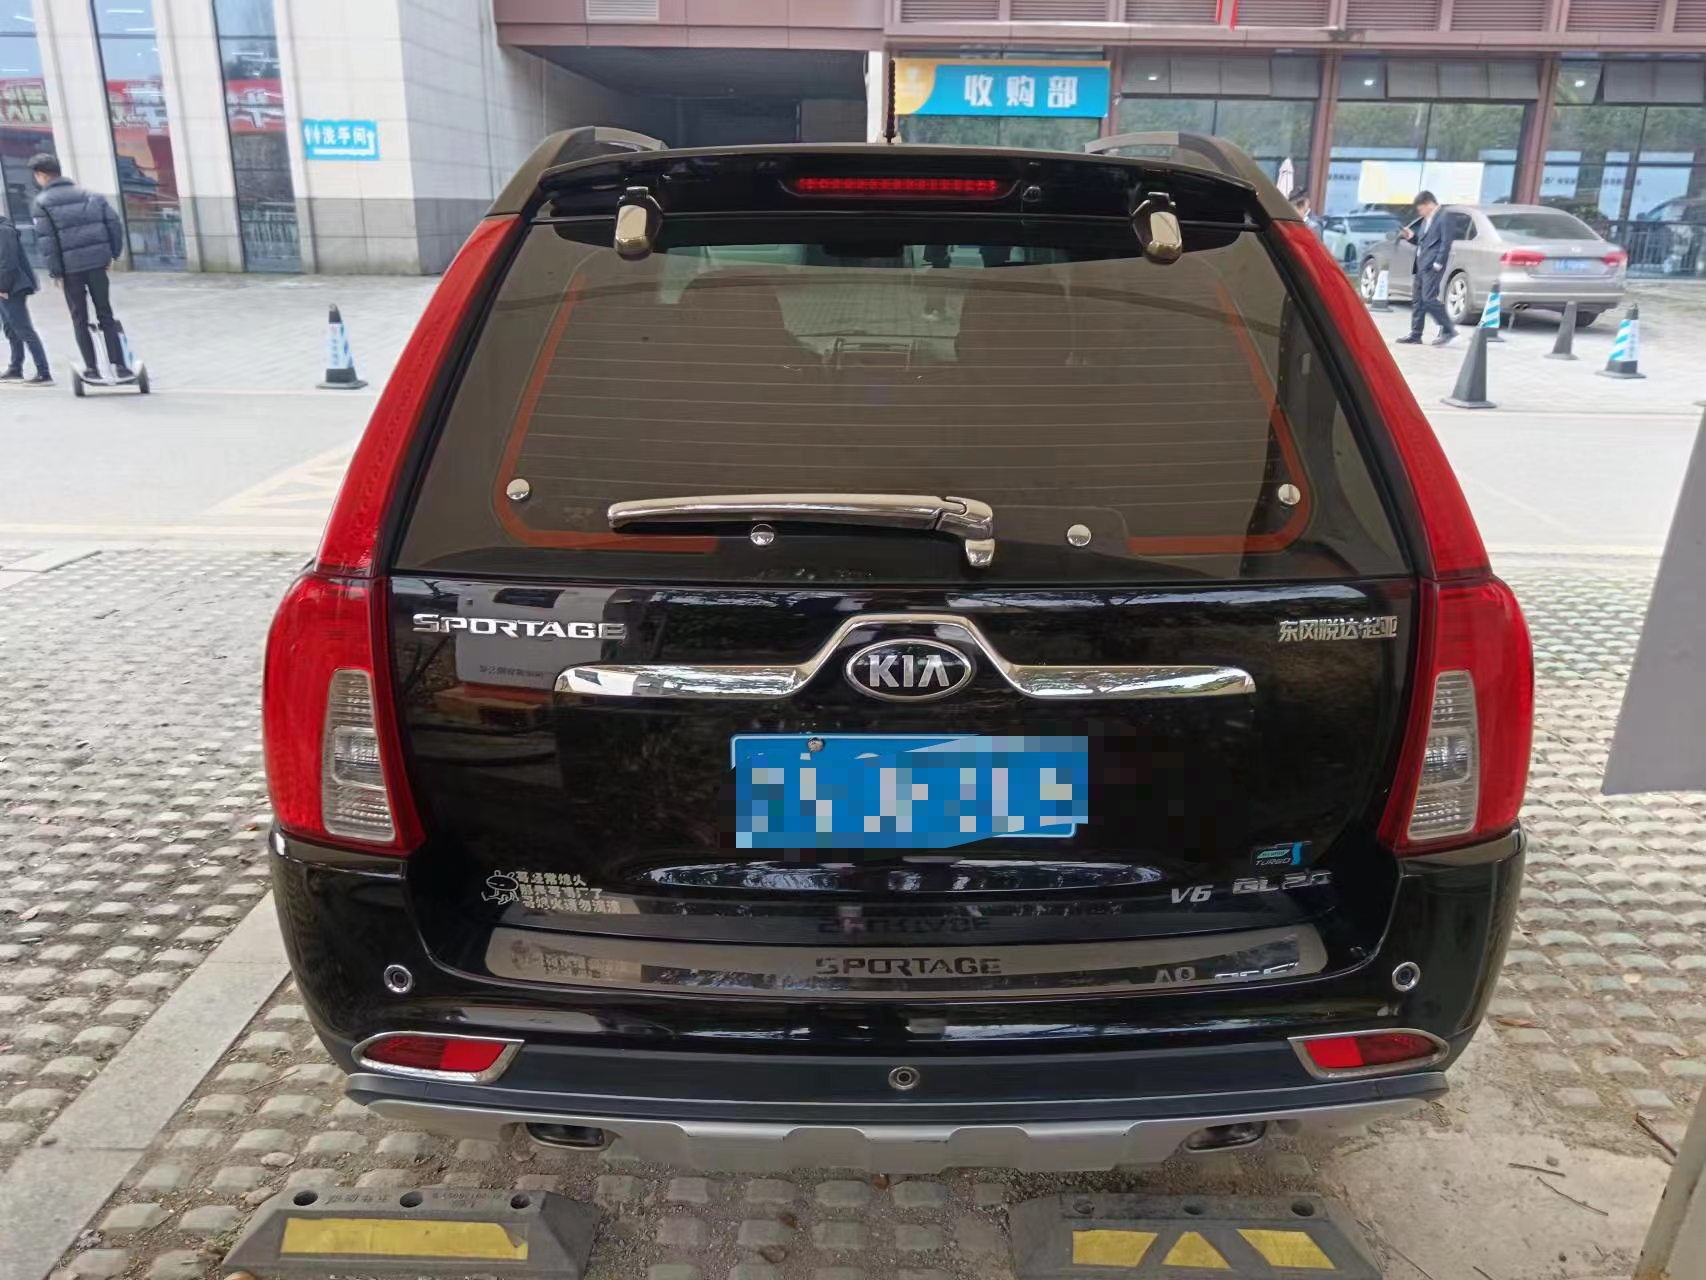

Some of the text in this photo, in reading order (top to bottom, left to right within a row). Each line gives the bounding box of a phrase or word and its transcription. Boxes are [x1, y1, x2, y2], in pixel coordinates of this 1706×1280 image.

[964, 74, 1079, 108] 收购部
[322, 126, 367, 145] 洗手间
[412, 613, 627, 640] SPORTAGE
[1278, 615, 1398, 643] 东风悦达起亚
[868, 654, 950, 687] KIA
[1170, 884, 1214, 905] V6
[815, 957, 1001, 977] SPORTAGE
